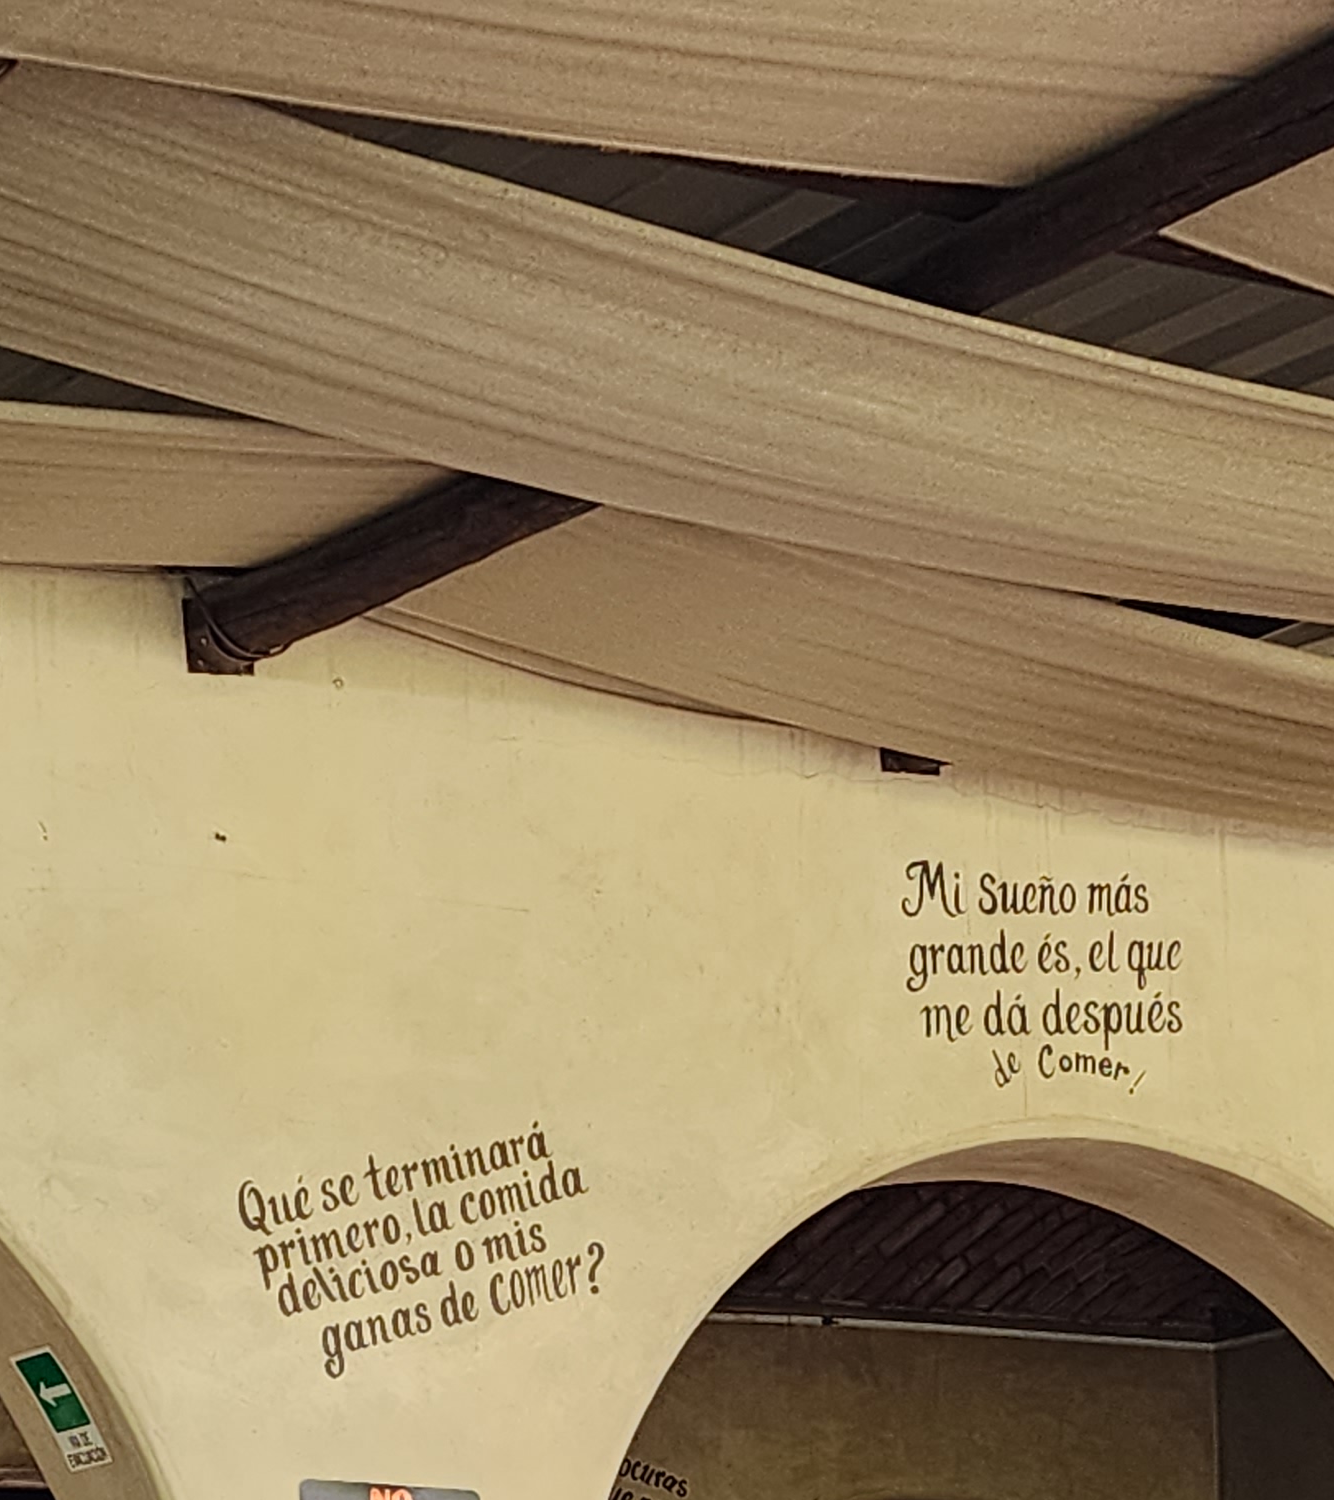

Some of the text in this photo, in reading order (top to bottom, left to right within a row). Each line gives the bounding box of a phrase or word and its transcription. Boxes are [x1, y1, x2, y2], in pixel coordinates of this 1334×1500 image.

[901, 859, 968, 919] Mi
[1086, 873, 1150, 918] más
[906, 928, 1029, 993] grande
[1088, 929, 1121, 974] el
[1127, 938, 1184, 991] que
[919, 987, 1184, 1051] me dá después
[991, 1048, 1022, 1089] de
[237, 1119, 554, 1237] Qué se terminará
[412, 1197, 456, 1240] la
[459, 1159, 590, 1226] comida
[275, 1218, 549, 1319] deliciosa o mis
[321, 1296, 434, 1379] ganas
[439, 1279, 480, 1328] de
